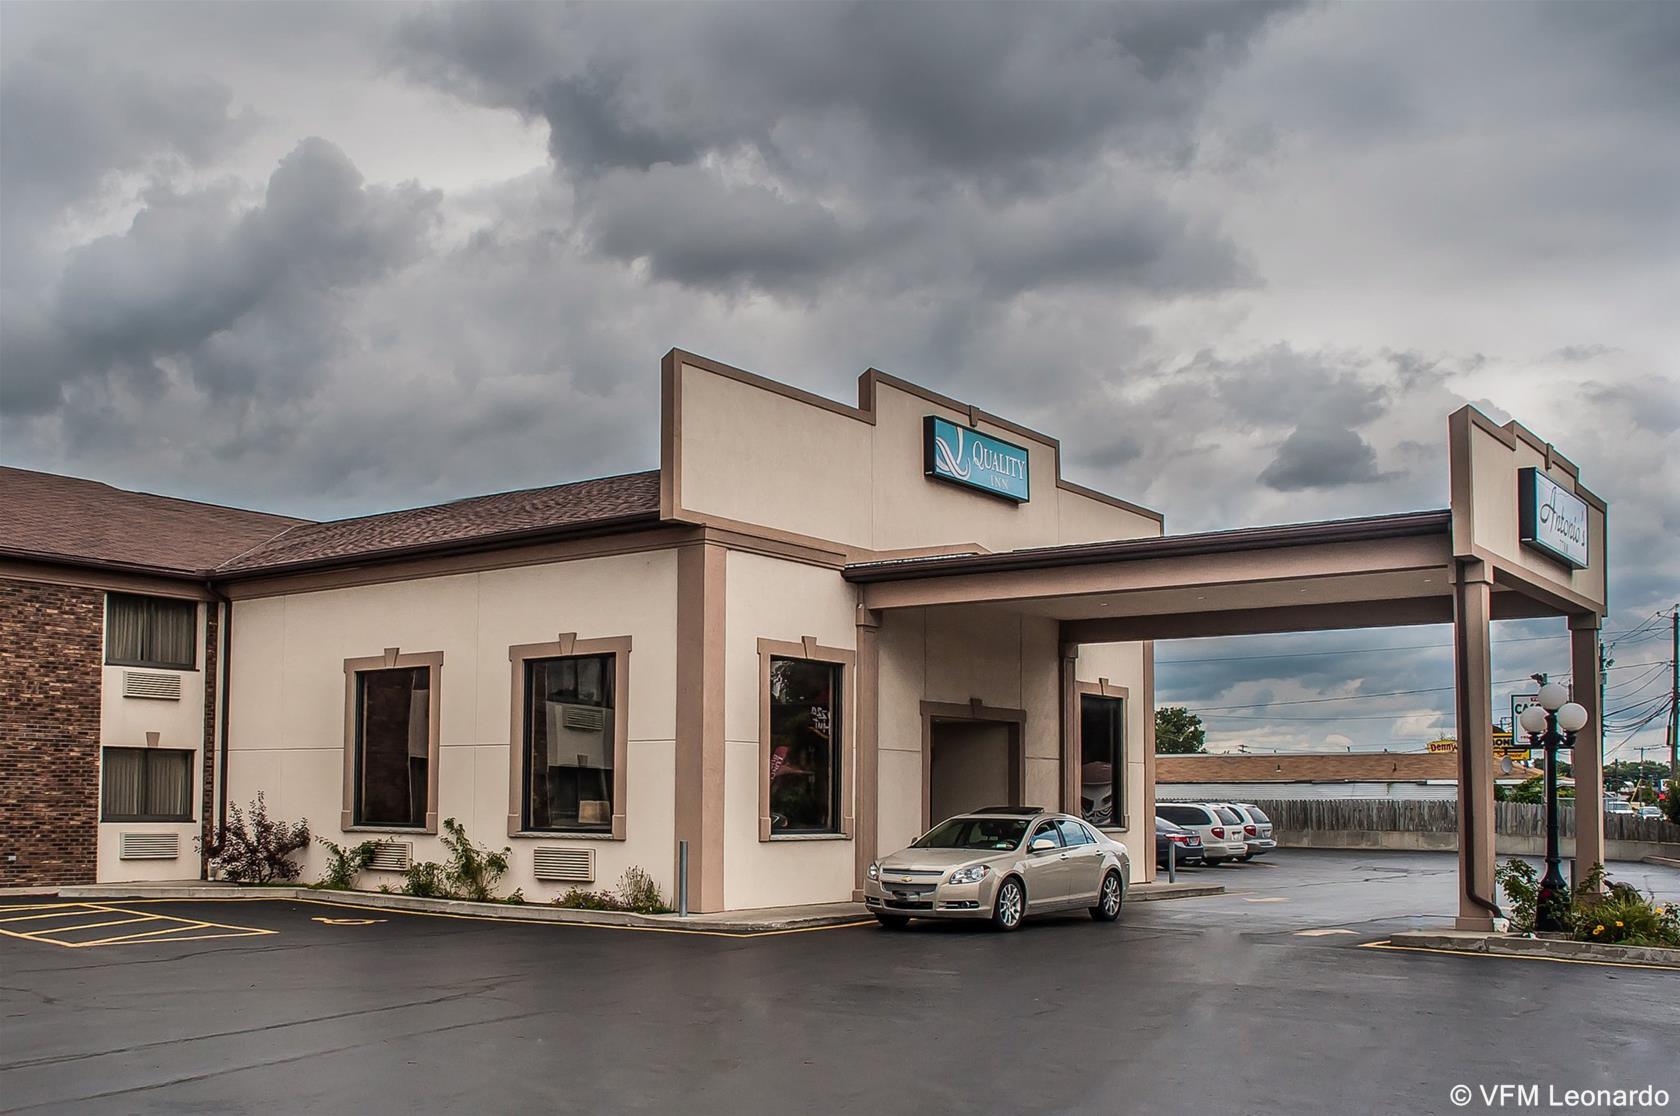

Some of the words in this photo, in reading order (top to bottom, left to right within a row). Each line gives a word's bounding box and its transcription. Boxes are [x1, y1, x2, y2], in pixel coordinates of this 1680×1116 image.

[973, 440, 1025, 480] QUALITY
[990, 474, 1009, 490] INN
[1430, 743, 1458, 752] Denny
